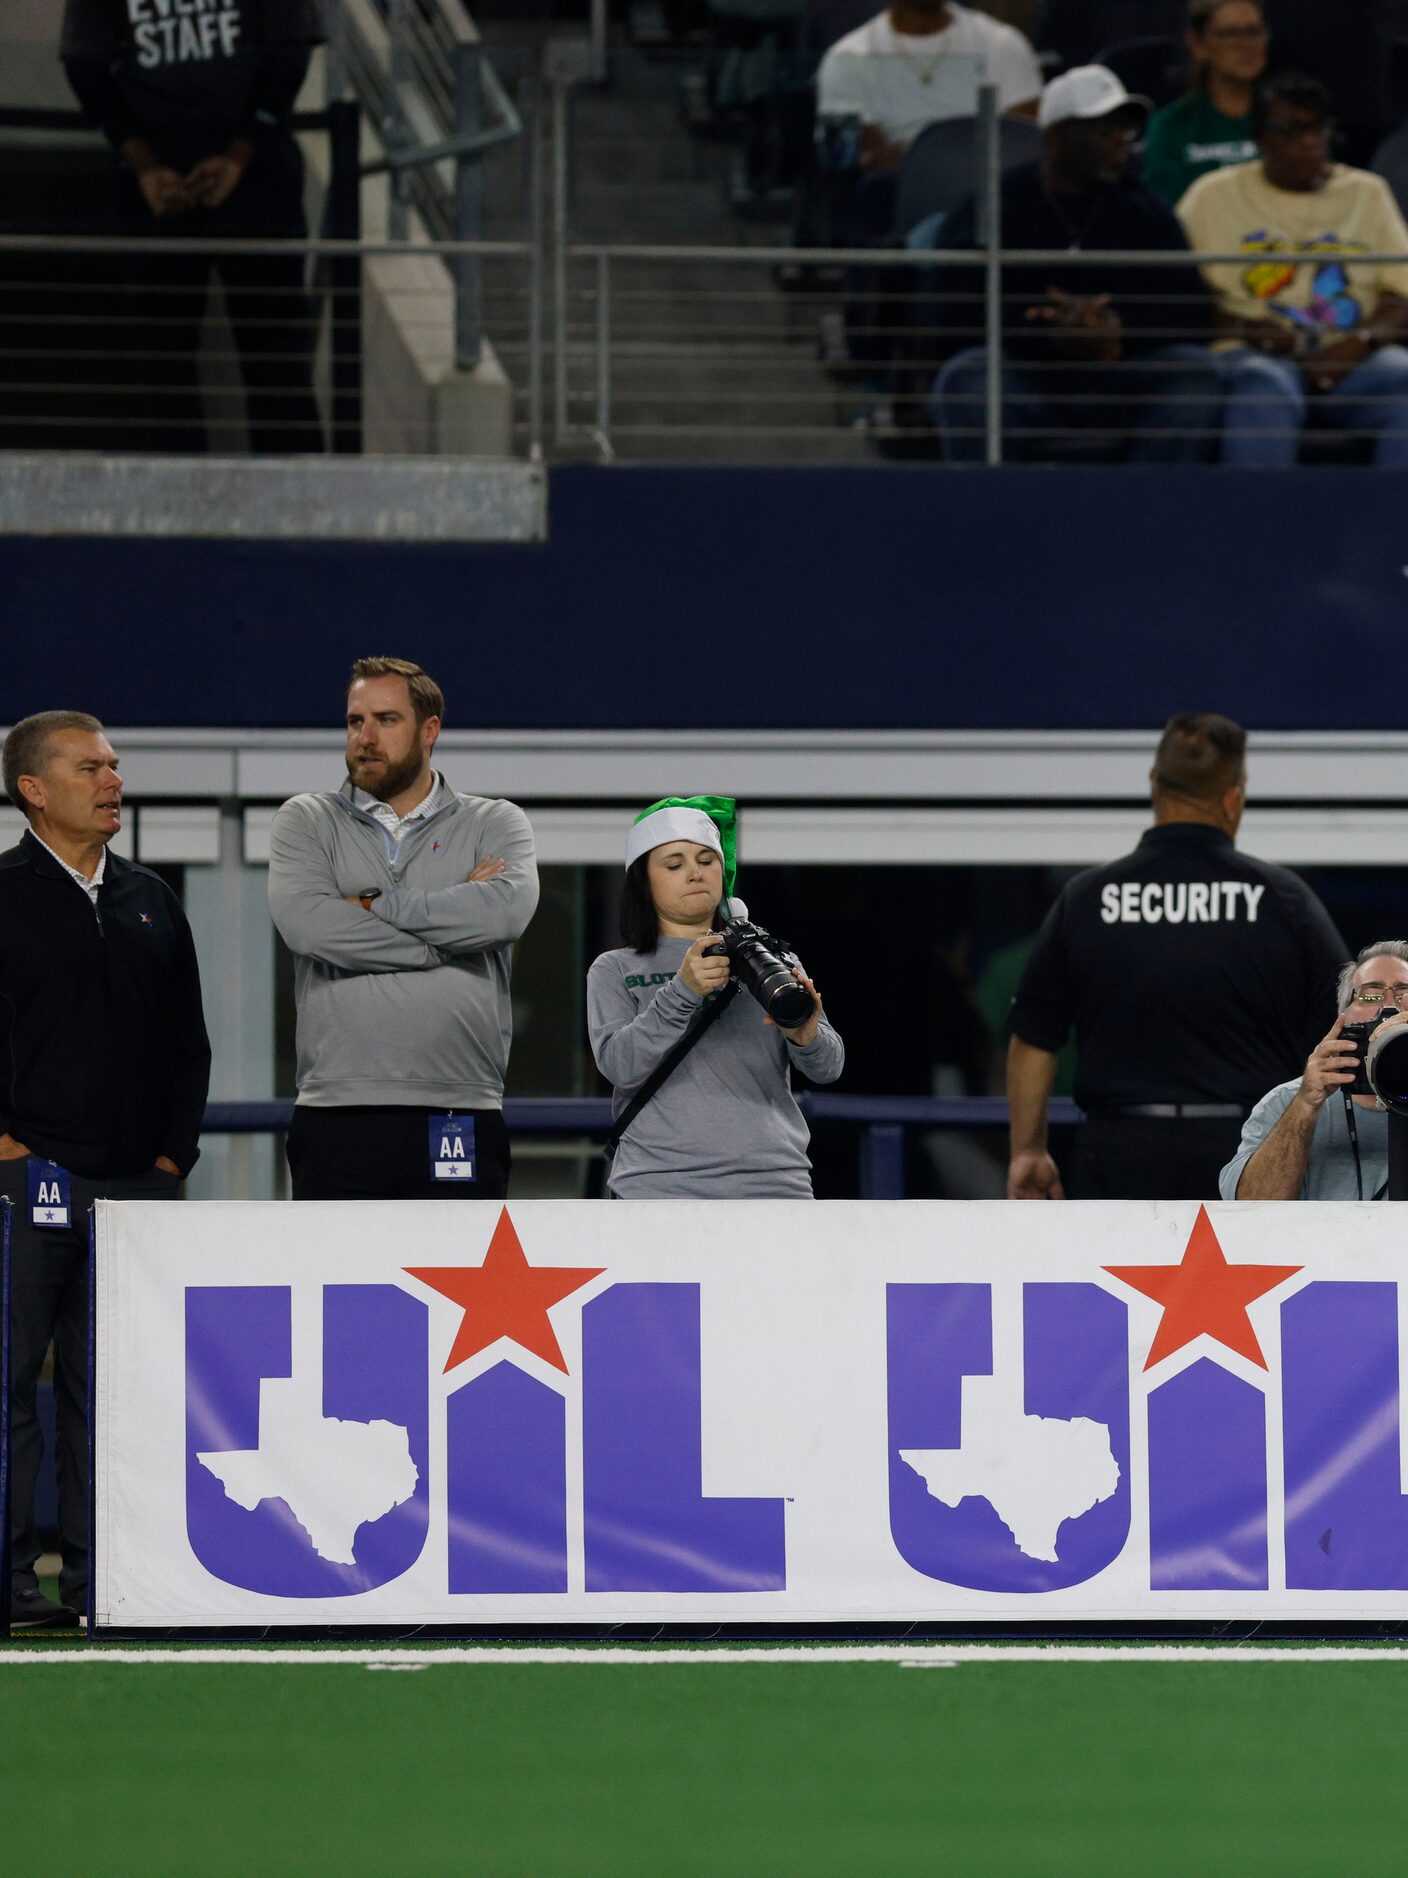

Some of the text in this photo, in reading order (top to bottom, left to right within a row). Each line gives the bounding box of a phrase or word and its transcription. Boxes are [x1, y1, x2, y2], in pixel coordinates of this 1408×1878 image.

[134, 10, 241, 68] STAFF
[1100, 881, 1266, 924] SECURITY
[440, 1136, 465, 1158] AA
[37, 1181, 62, 1204] AA
